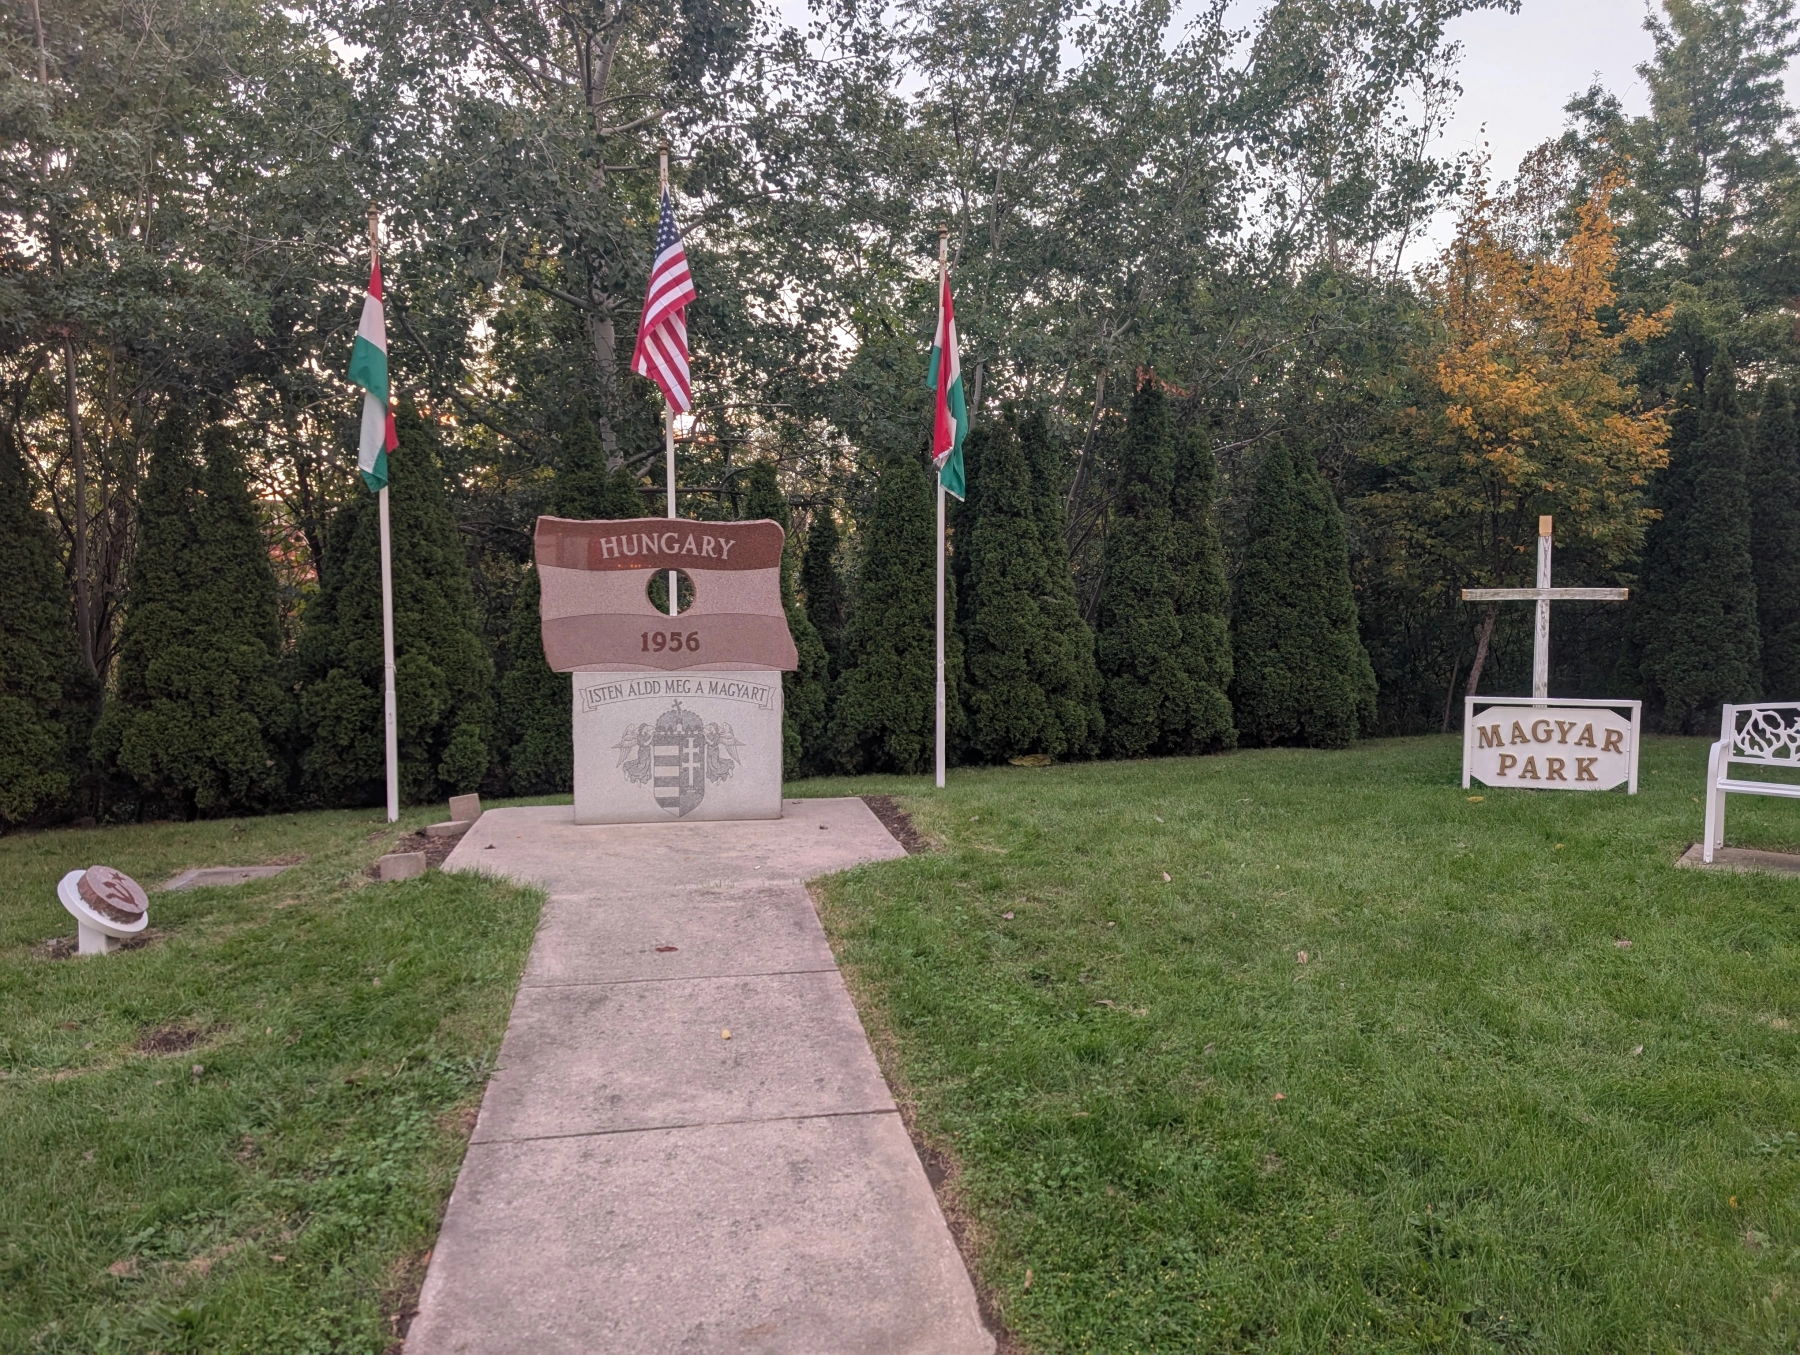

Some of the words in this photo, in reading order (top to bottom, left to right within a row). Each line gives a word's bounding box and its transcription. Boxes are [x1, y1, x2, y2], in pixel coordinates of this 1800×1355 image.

[600, 532, 736, 560] HUNGARY
[641, 631, 700, 653] 1956
[588, 684, 623, 704] ISTEN
[665, 679, 691, 695] MEG
[695, 681, 704, 694] A
[708, 681, 768, 703] MAGYART
[1477, 719, 1624, 754] MAGYAR
[1497, 753, 1598, 781] PARK
